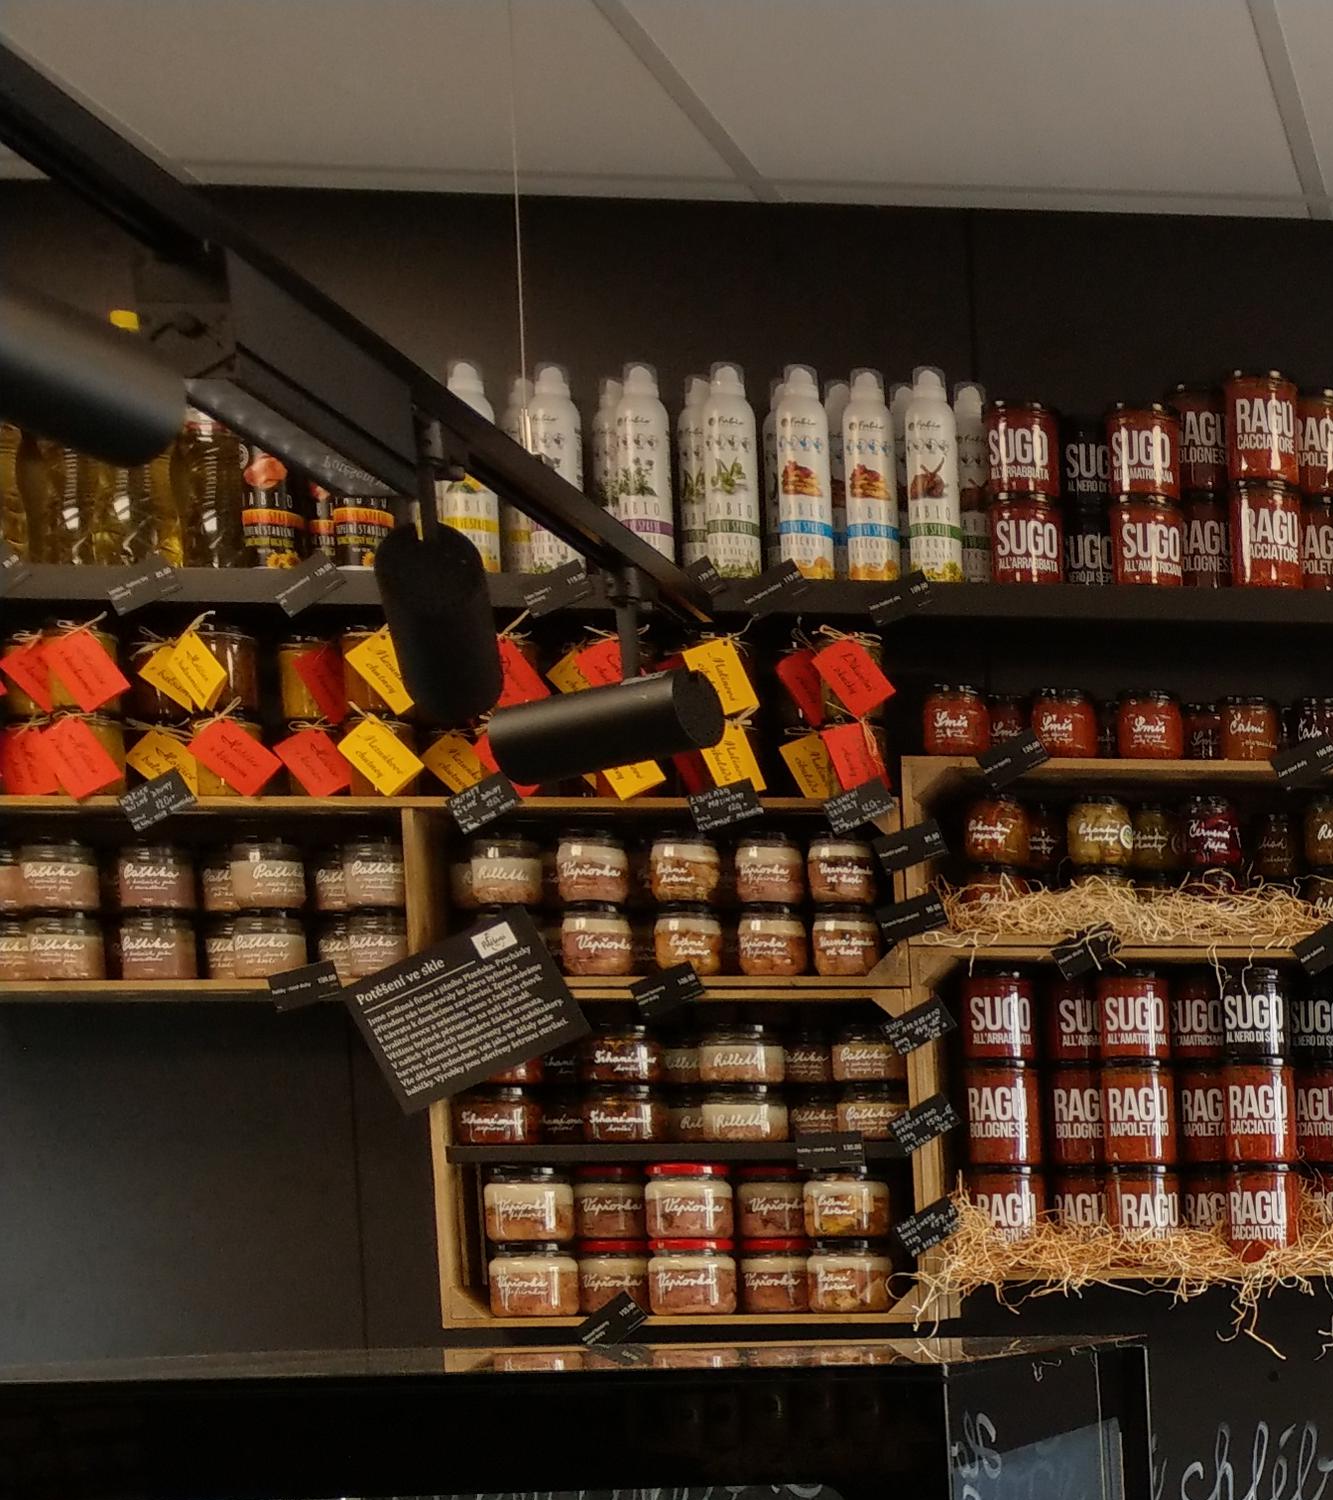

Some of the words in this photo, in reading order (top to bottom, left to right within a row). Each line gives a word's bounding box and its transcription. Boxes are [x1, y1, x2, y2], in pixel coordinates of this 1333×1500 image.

[989, 428, 1048, 465] SUGO
[1181, 412, 1225, 446] AG
[1066, 444, 1110, 479] SUG
[1112, 430, 1170, 468] SUGO
[996, 520, 1057, 558] SUGO
[1065, 534, 1113, 569] UGO
[1122, 522, 1180, 562] SUGO
[1182, 520, 1228, 555] AG
[1250, 544, 1299, 564] ACCIATORE
[356, 976, 406, 1005] Potěšení
[408, 971, 421, 983] ve
[422, 958, 445, 976] skle
[970, 996, 1031, 1031] SUGO
[1059, 999, 1101, 1033] SUG
[1106, 997, 1164, 1032] SUGO
[1225, 995, 1283, 1029] SUGO
[1235, 1031, 1254, 1043] NERO
[1255, 1031, 1264, 1043] DI
[1054, 1089, 1104, 1122] RAG
[1182, 1089, 1223, 1122] RAG
[1056, 1123, 1103, 1138] BOLOGNE
